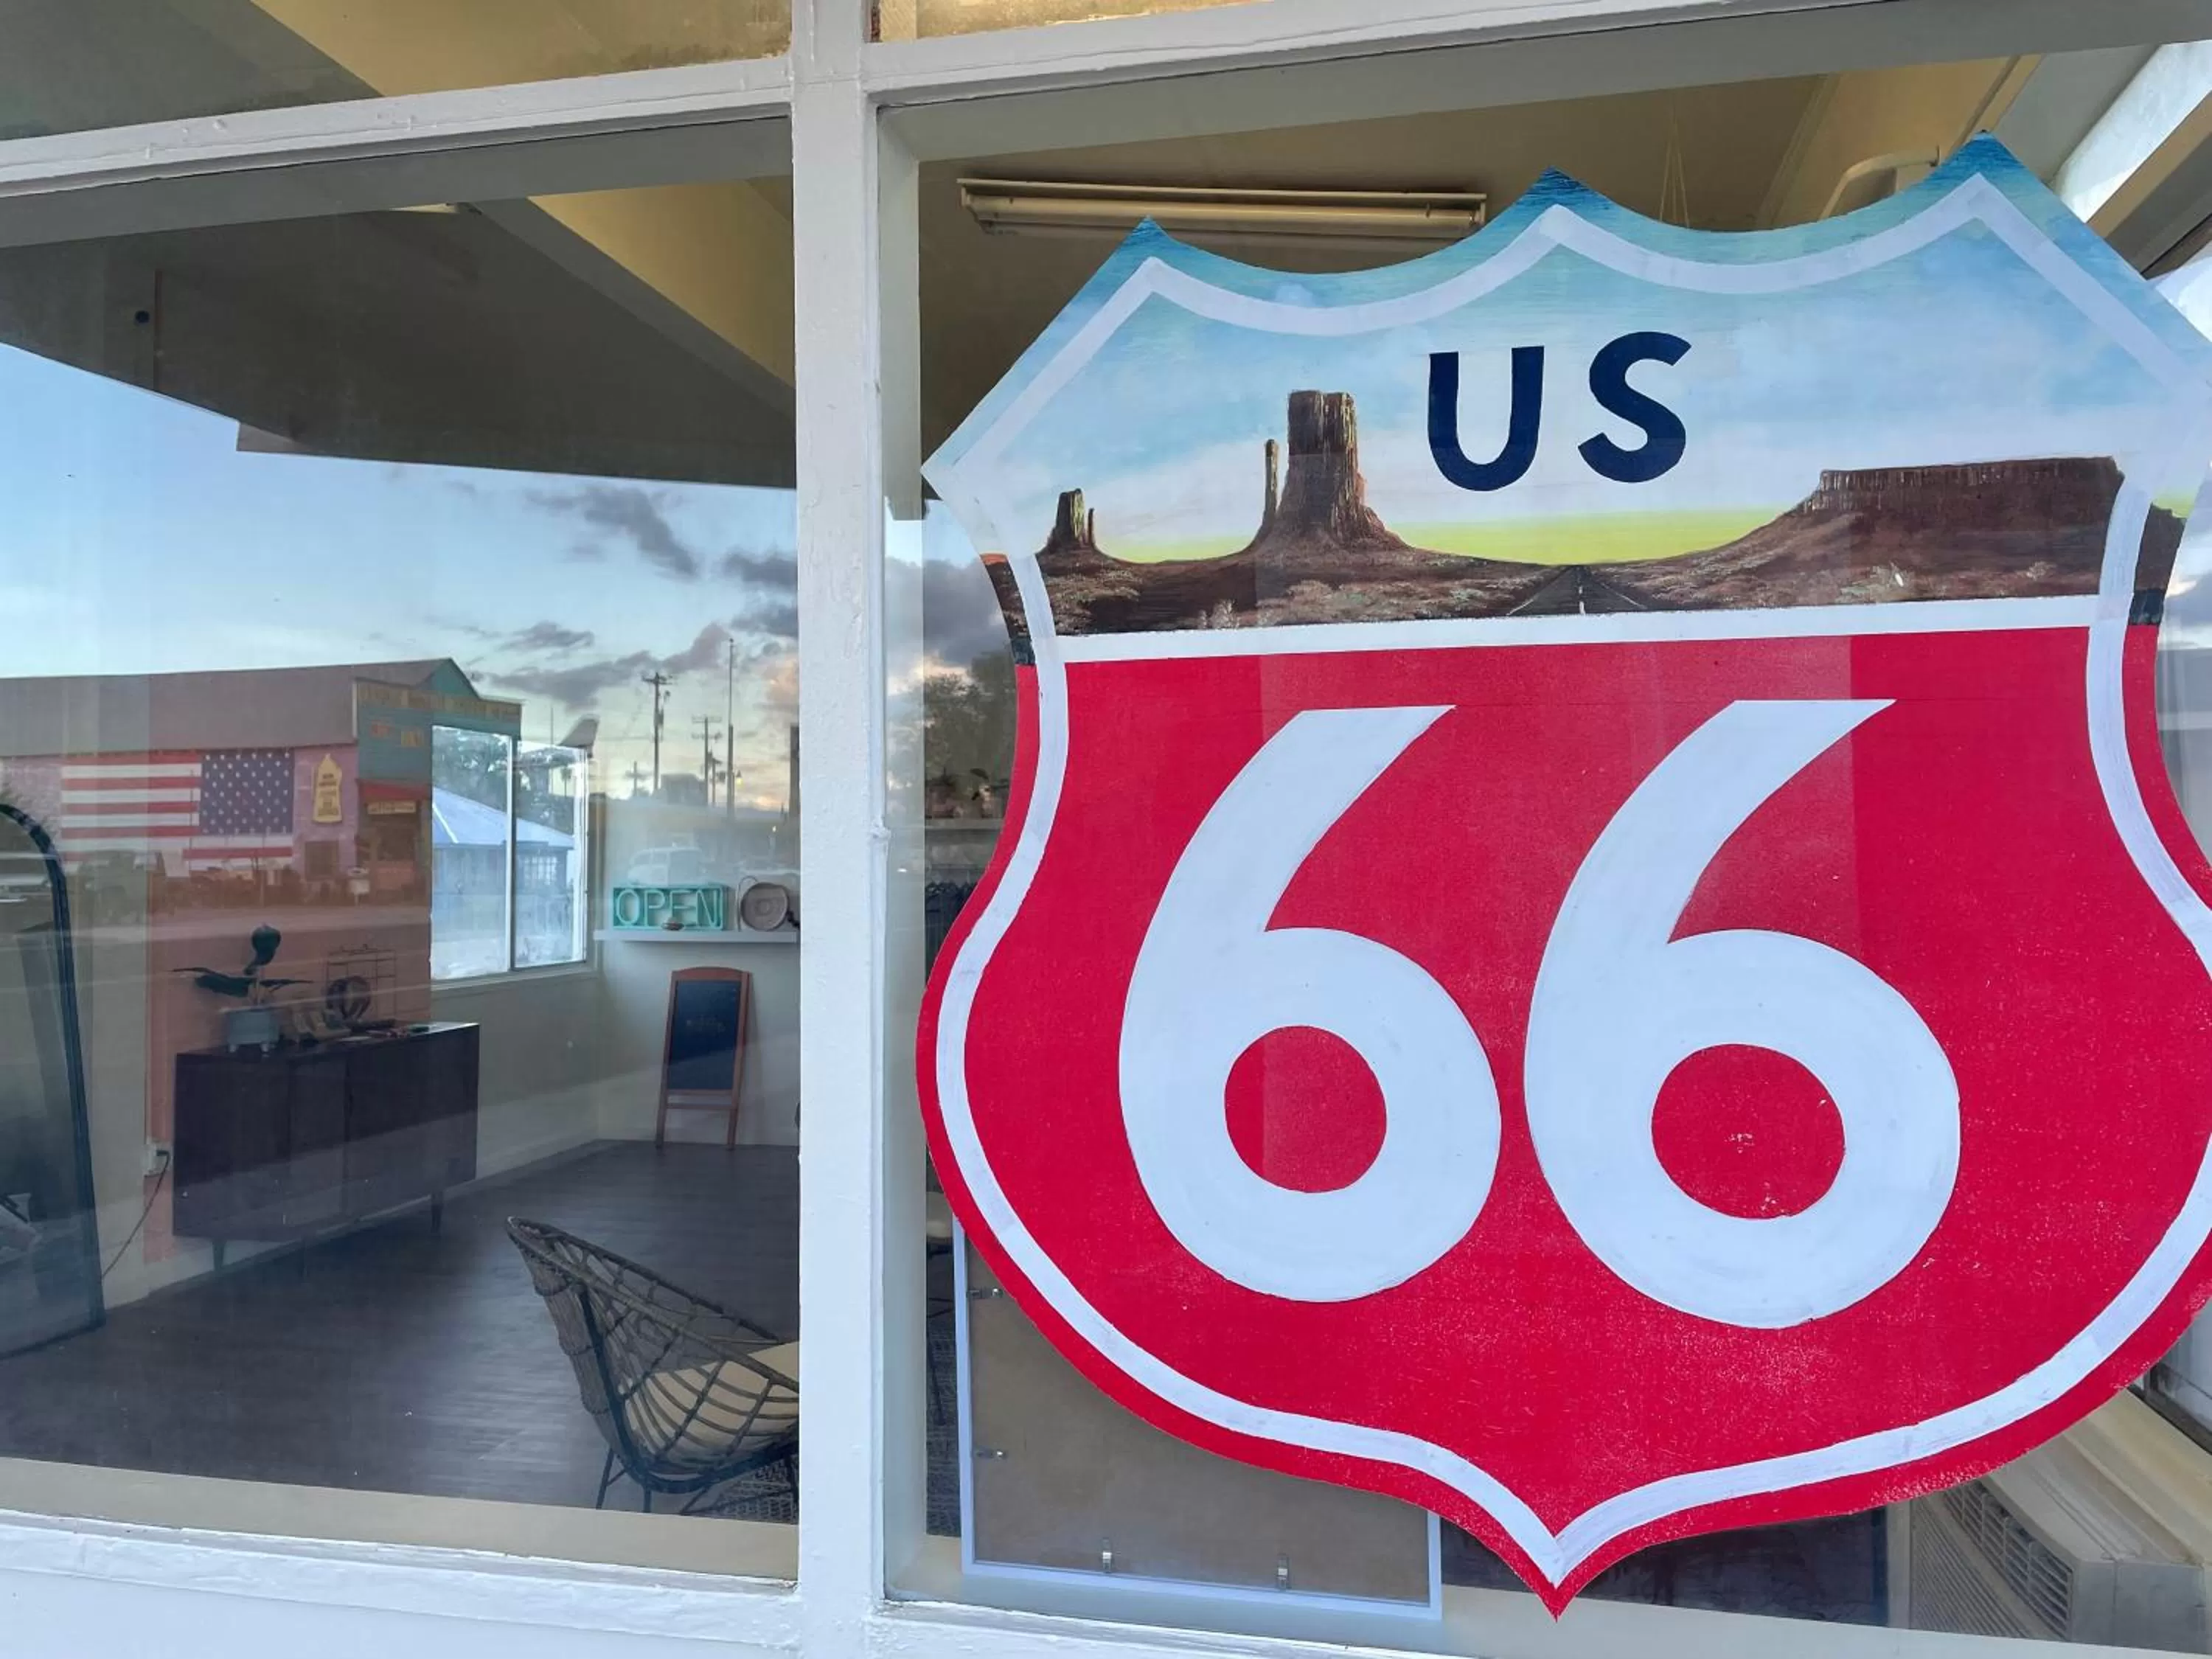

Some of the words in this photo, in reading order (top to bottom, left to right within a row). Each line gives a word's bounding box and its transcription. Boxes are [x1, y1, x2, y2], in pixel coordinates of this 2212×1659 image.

[1427, 331, 1691, 491] US
[616, 888, 718, 928] OPEN
[1119, 699, 1961, 1329] 66
